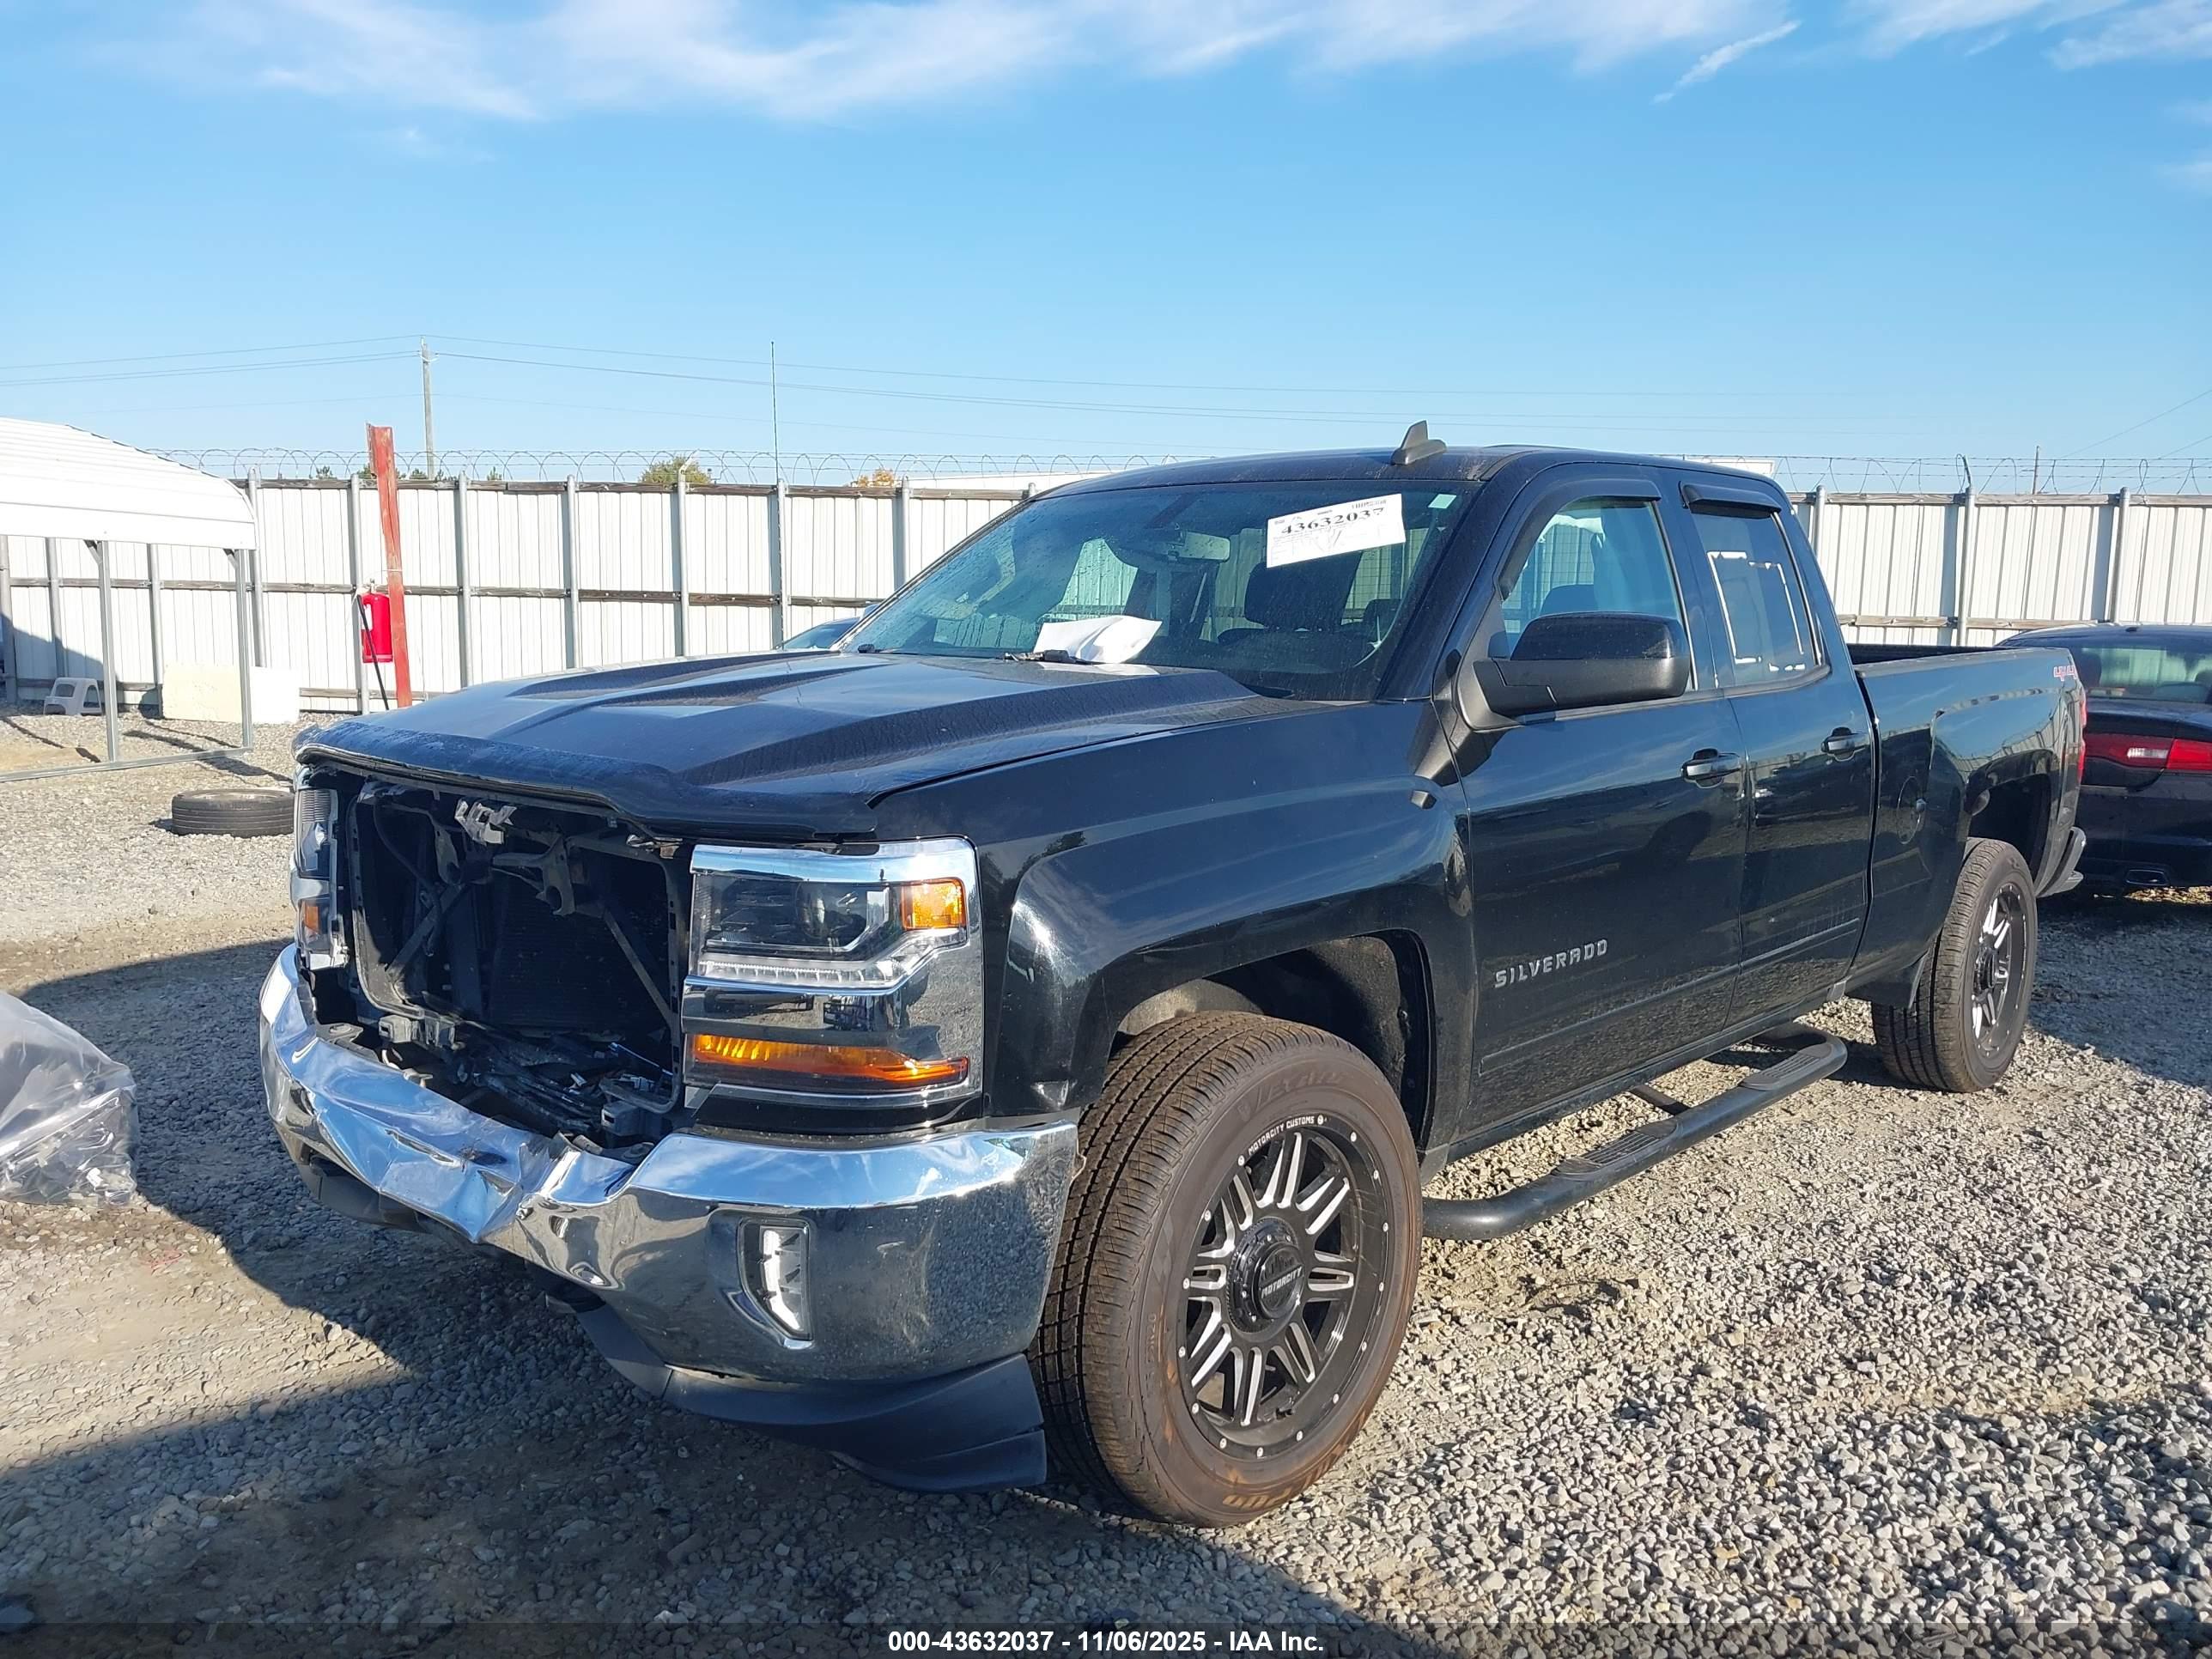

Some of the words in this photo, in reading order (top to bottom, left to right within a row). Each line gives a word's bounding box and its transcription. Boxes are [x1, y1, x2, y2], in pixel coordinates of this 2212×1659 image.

[1281, 507, 1385, 534] 43632037
[1494, 939, 1608, 988] SILVERADO
[1248, 1123, 1285, 1156] MOTORCITY
[1285, 1115, 1315, 1129] CUSTOMS
[1261, 1266, 1303, 1299] MOTORCITY
